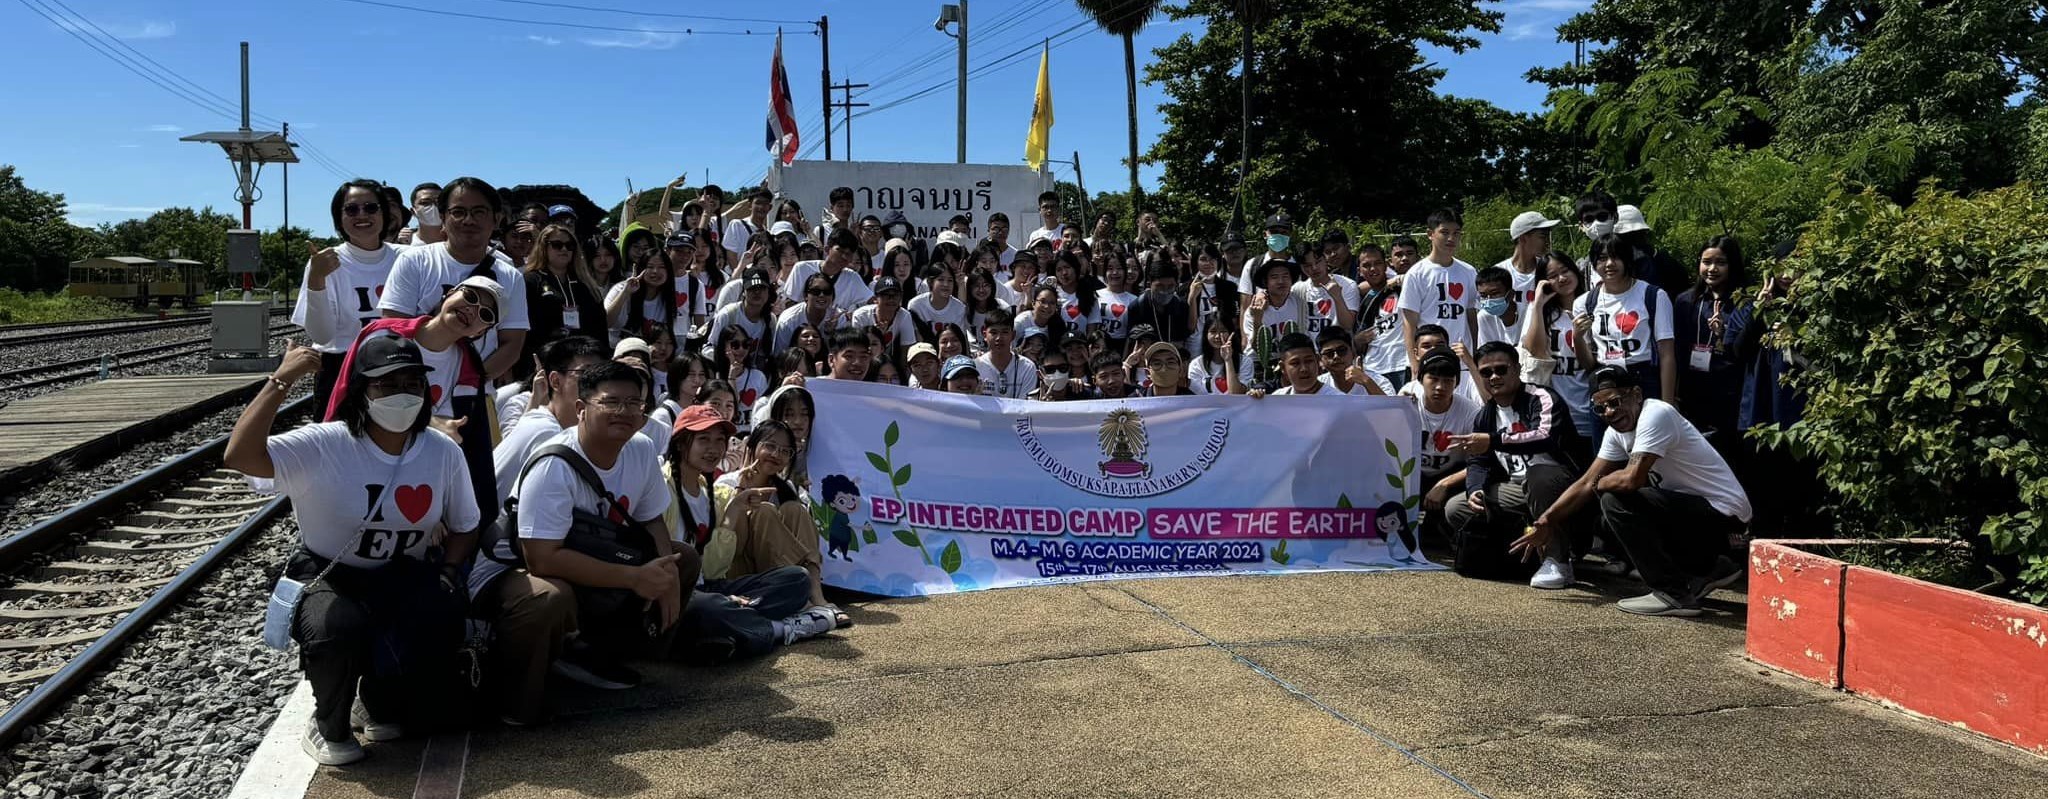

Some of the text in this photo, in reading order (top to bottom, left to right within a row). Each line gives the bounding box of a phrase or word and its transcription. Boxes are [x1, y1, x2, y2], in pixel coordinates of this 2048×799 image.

[857, 179, 992, 223] าญจนบุรี
[355, 287, 373, 311] I
[1436, 283, 1446, 301] I
[1437, 303, 1464, 320] EP
[1599, 314, 1610, 336] I
[1551, 329, 1560, 351] I
[1197, 418, 1226, 467] SCHOOL
[363, 484, 384, 522] I
[871, 497, 1366, 535] EP INTEGRATED CAMP SAVE THE EARTH
[354, 529, 425, 560] EP
[994, 541, 1012, 555] M.
[1016, 543, 1027, 556] 4
[1042, 543, 1061, 558] M.
[1065, 544, 1076, 558] 6
[1081, 544, 1171, 560] ACADEMIC
[1175, 545, 1218, 560] YEAR
[1222, 545, 1260, 560] 2024
[1038, 561, 1065, 576] 15th
[1082, 563, 1108, 575] 17th
